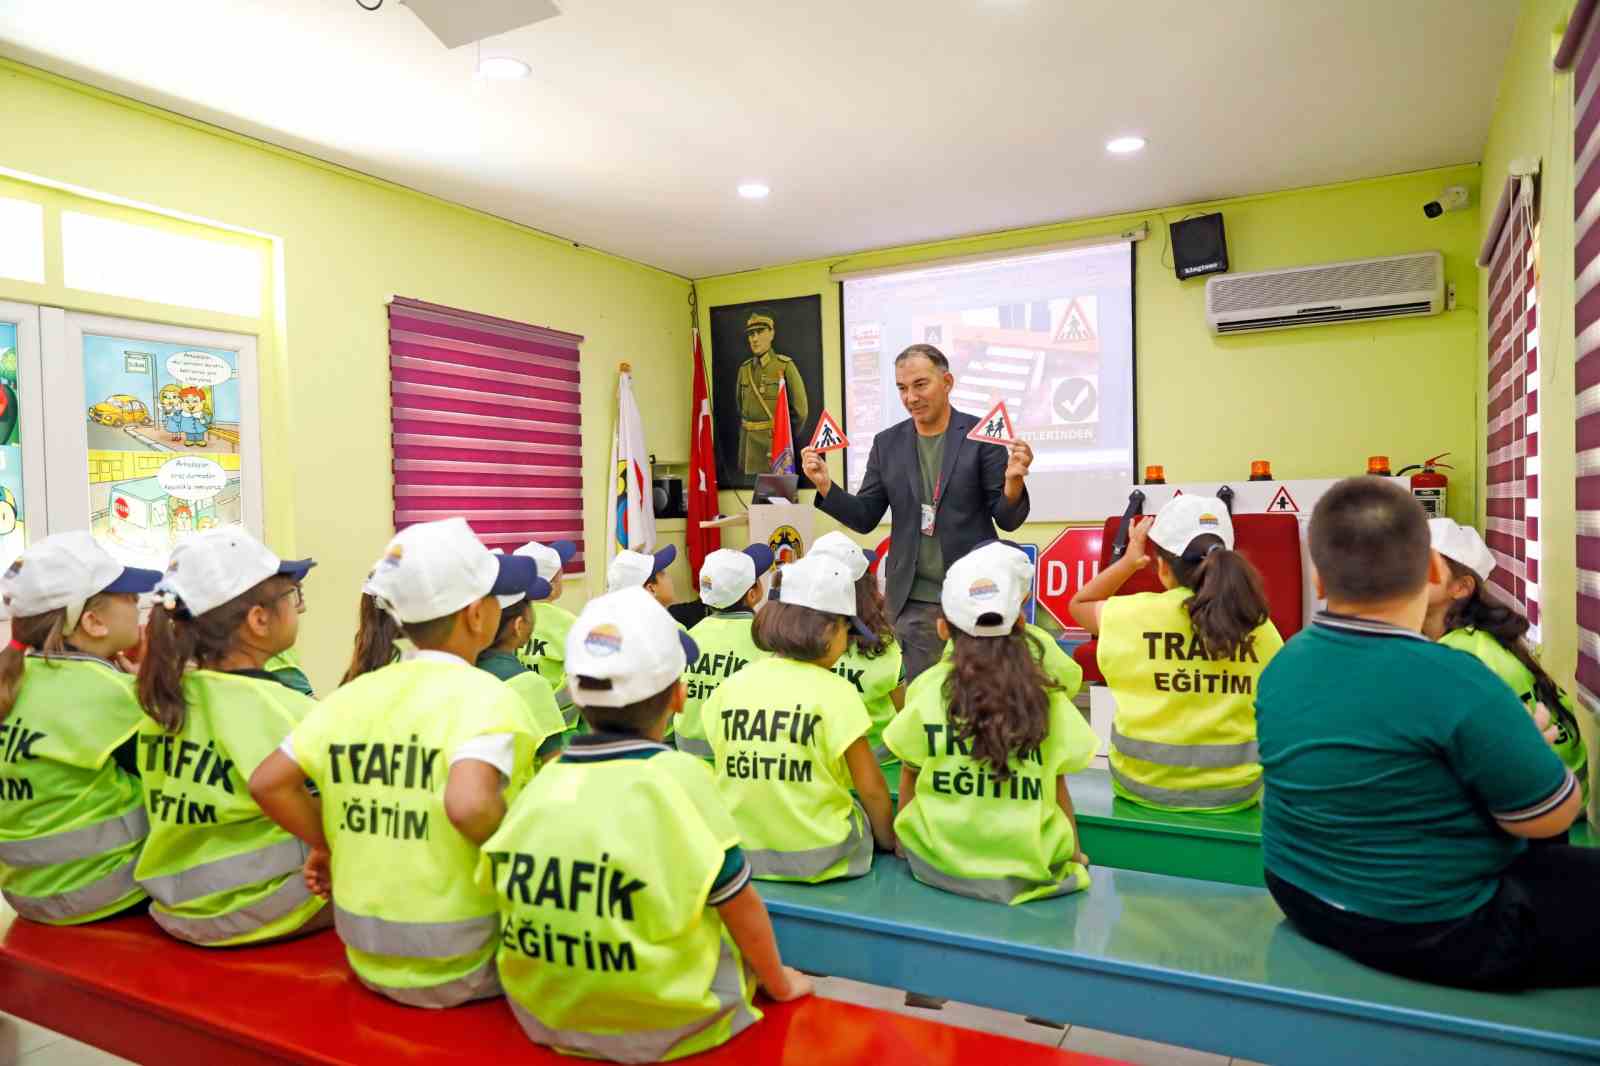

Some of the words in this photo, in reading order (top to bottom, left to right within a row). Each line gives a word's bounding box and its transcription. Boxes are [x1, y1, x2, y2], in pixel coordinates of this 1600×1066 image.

[1046, 559, 1100, 597] DU
[1153, 668, 1253, 696] EĞİTİM
[721, 703, 823, 748] TRAFİK
[726, 750, 813, 783] EĞİTİM
[339, 797, 430, 841] ĞİTİM
[486, 852, 648, 922] TRAFİK
[502, 914, 637, 973] EĞİTİM
